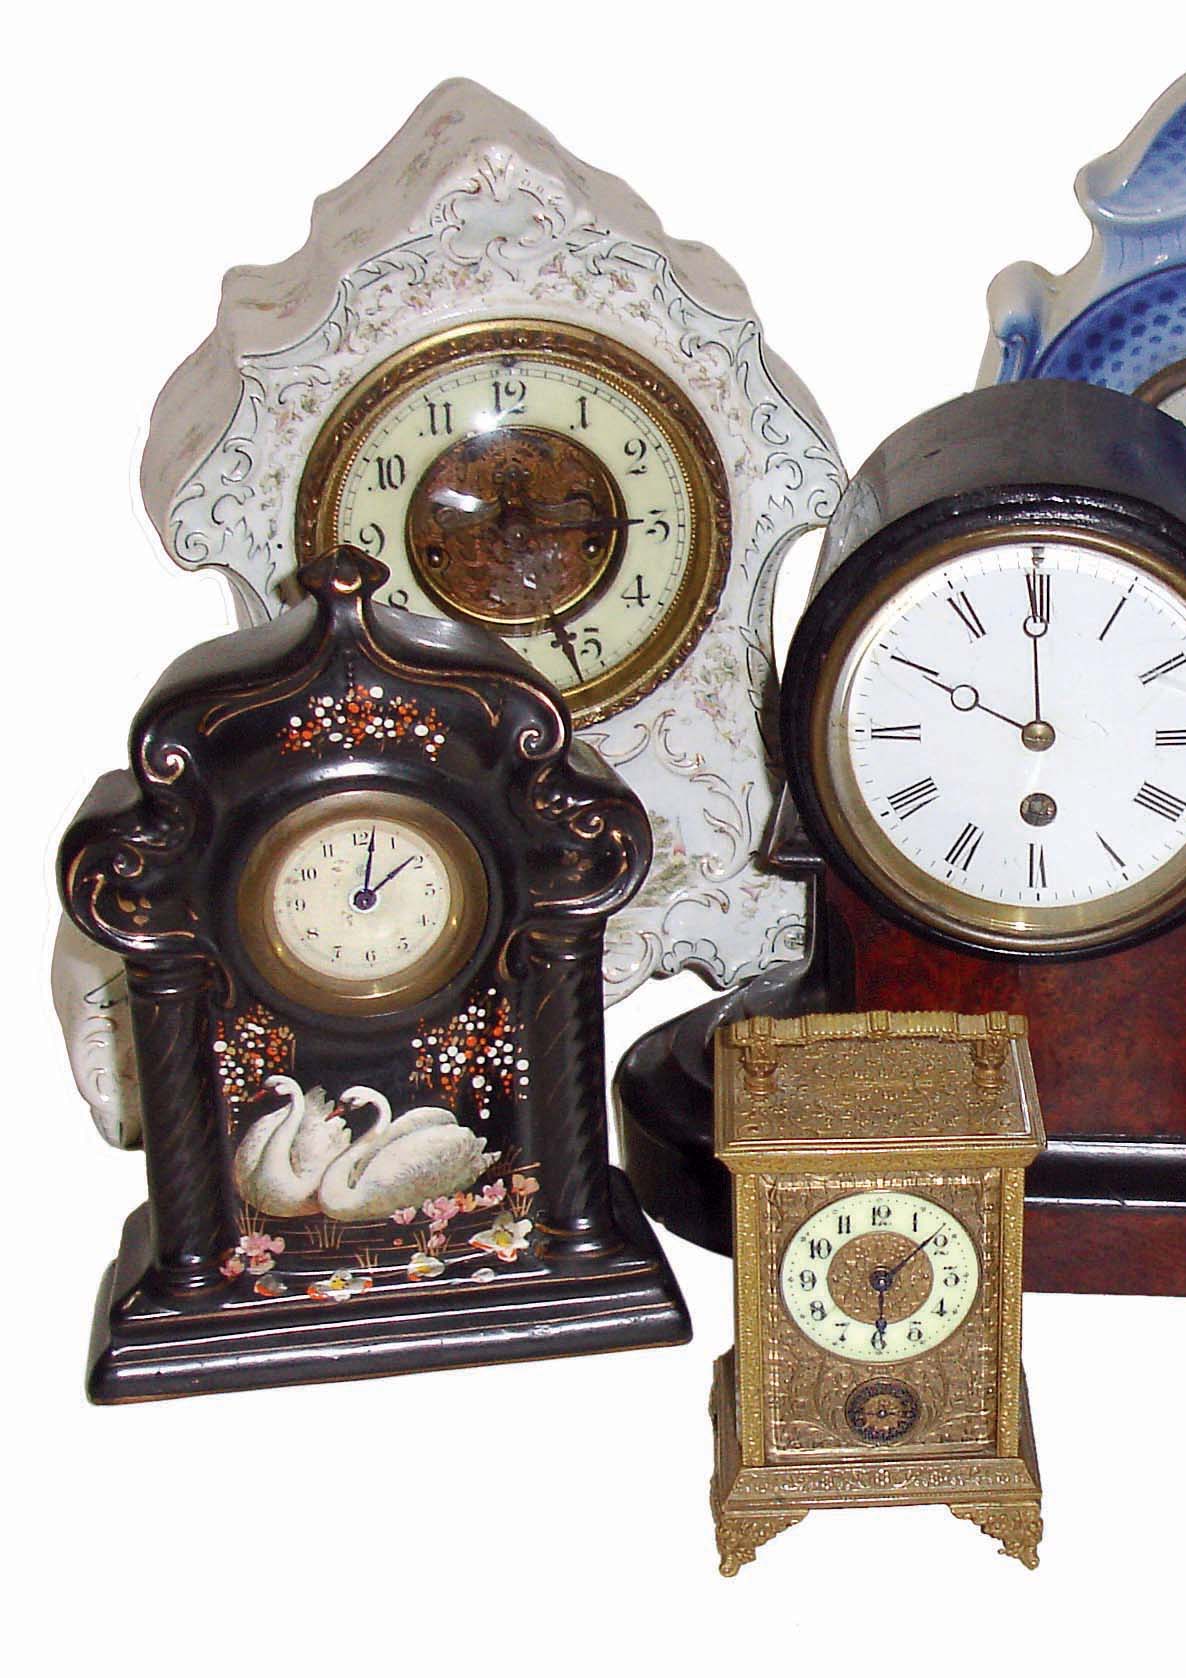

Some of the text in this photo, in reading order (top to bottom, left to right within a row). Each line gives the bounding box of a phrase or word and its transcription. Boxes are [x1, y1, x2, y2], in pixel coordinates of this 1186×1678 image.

[492, 379, 526, 414] 12
[428, 402, 452, 435] 11
[578, 396, 587, 429] 1
[624, 438, 647, 475] 2
[376, 453, 405, 490] 10
[646, 509, 670, 543] 3
[359, 523, 385, 555] 9
[621, 575, 650, 608] 4
[1099, 597, 1127, 640] I
[580, 627, 602, 660] 5
[1139, 652, 1186, 684] II
[871, 723, 921, 742] IX
[887, 777, 939, 819] VIII
[1133, 781, 1186, 822] IIII
[353, 831, 368, 846] 12
[391, 837, 395, 849] 1
[945, 823, 984, 871] VII
[323, 844, 333, 858] 11
[301, 868, 316, 881] 10
[1029, 843, 1047, 888] VI
[295, 899, 305, 911] 9
[307, 928, 319, 939] 8
[365, 950, 376, 962] 6
[837, 1215, 850, 1234] 11
[872, 1205, 891, 1227] 12
[912, 1212, 917, 1232] 1
[809, 1238, 832, 1259] 10
[934, 1233, 948, 1256] 2
[800, 1270, 817, 1291] 9
[944, 1266, 960, 1287] 3
[810, 1300, 827, 1321] 8
[930, 1297, 947, 1317] 4
[835, 1322, 849, 1341] 7
[907, 1321, 923, 1341] 5
